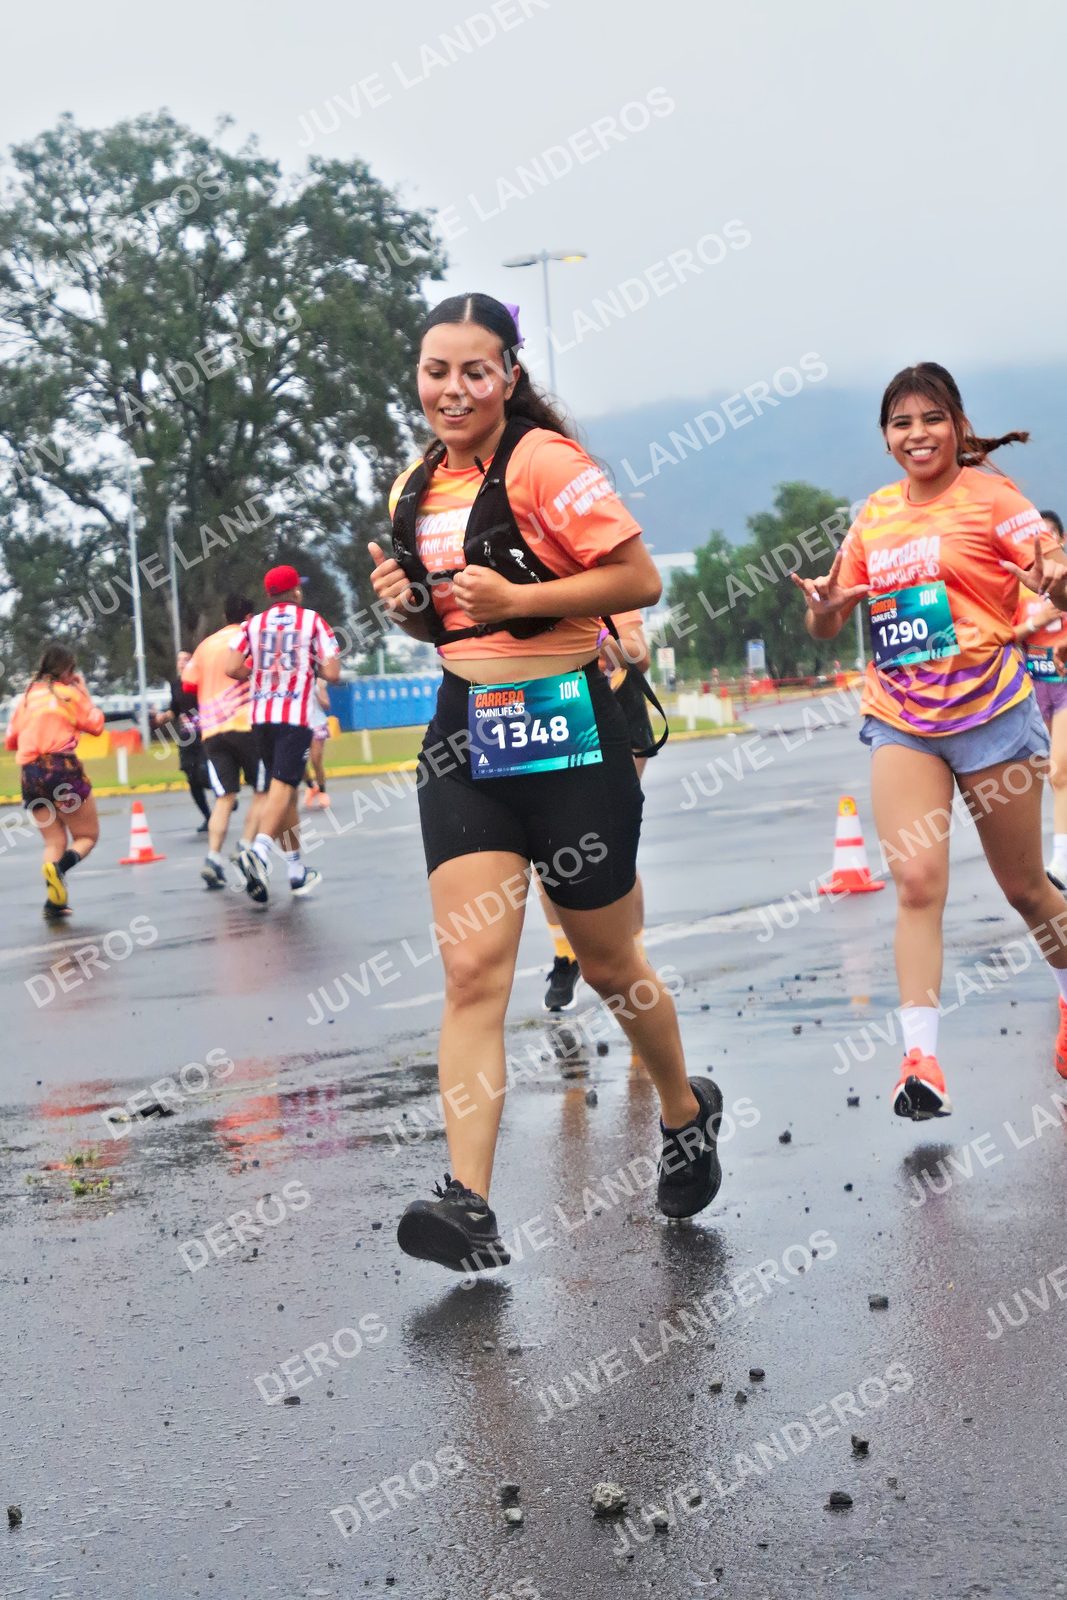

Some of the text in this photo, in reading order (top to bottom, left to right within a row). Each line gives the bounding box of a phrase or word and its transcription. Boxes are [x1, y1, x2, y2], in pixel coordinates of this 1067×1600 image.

[868, 536, 940, 575] CARRERA
[919, 589, 938, 606] 10K
[879, 618, 928, 647] 1290
[475, 680, 580, 708] CARRERA 10K
[475, 707, 513, 718] OMNILIFE
[491, 716, 569, 749] 1348
